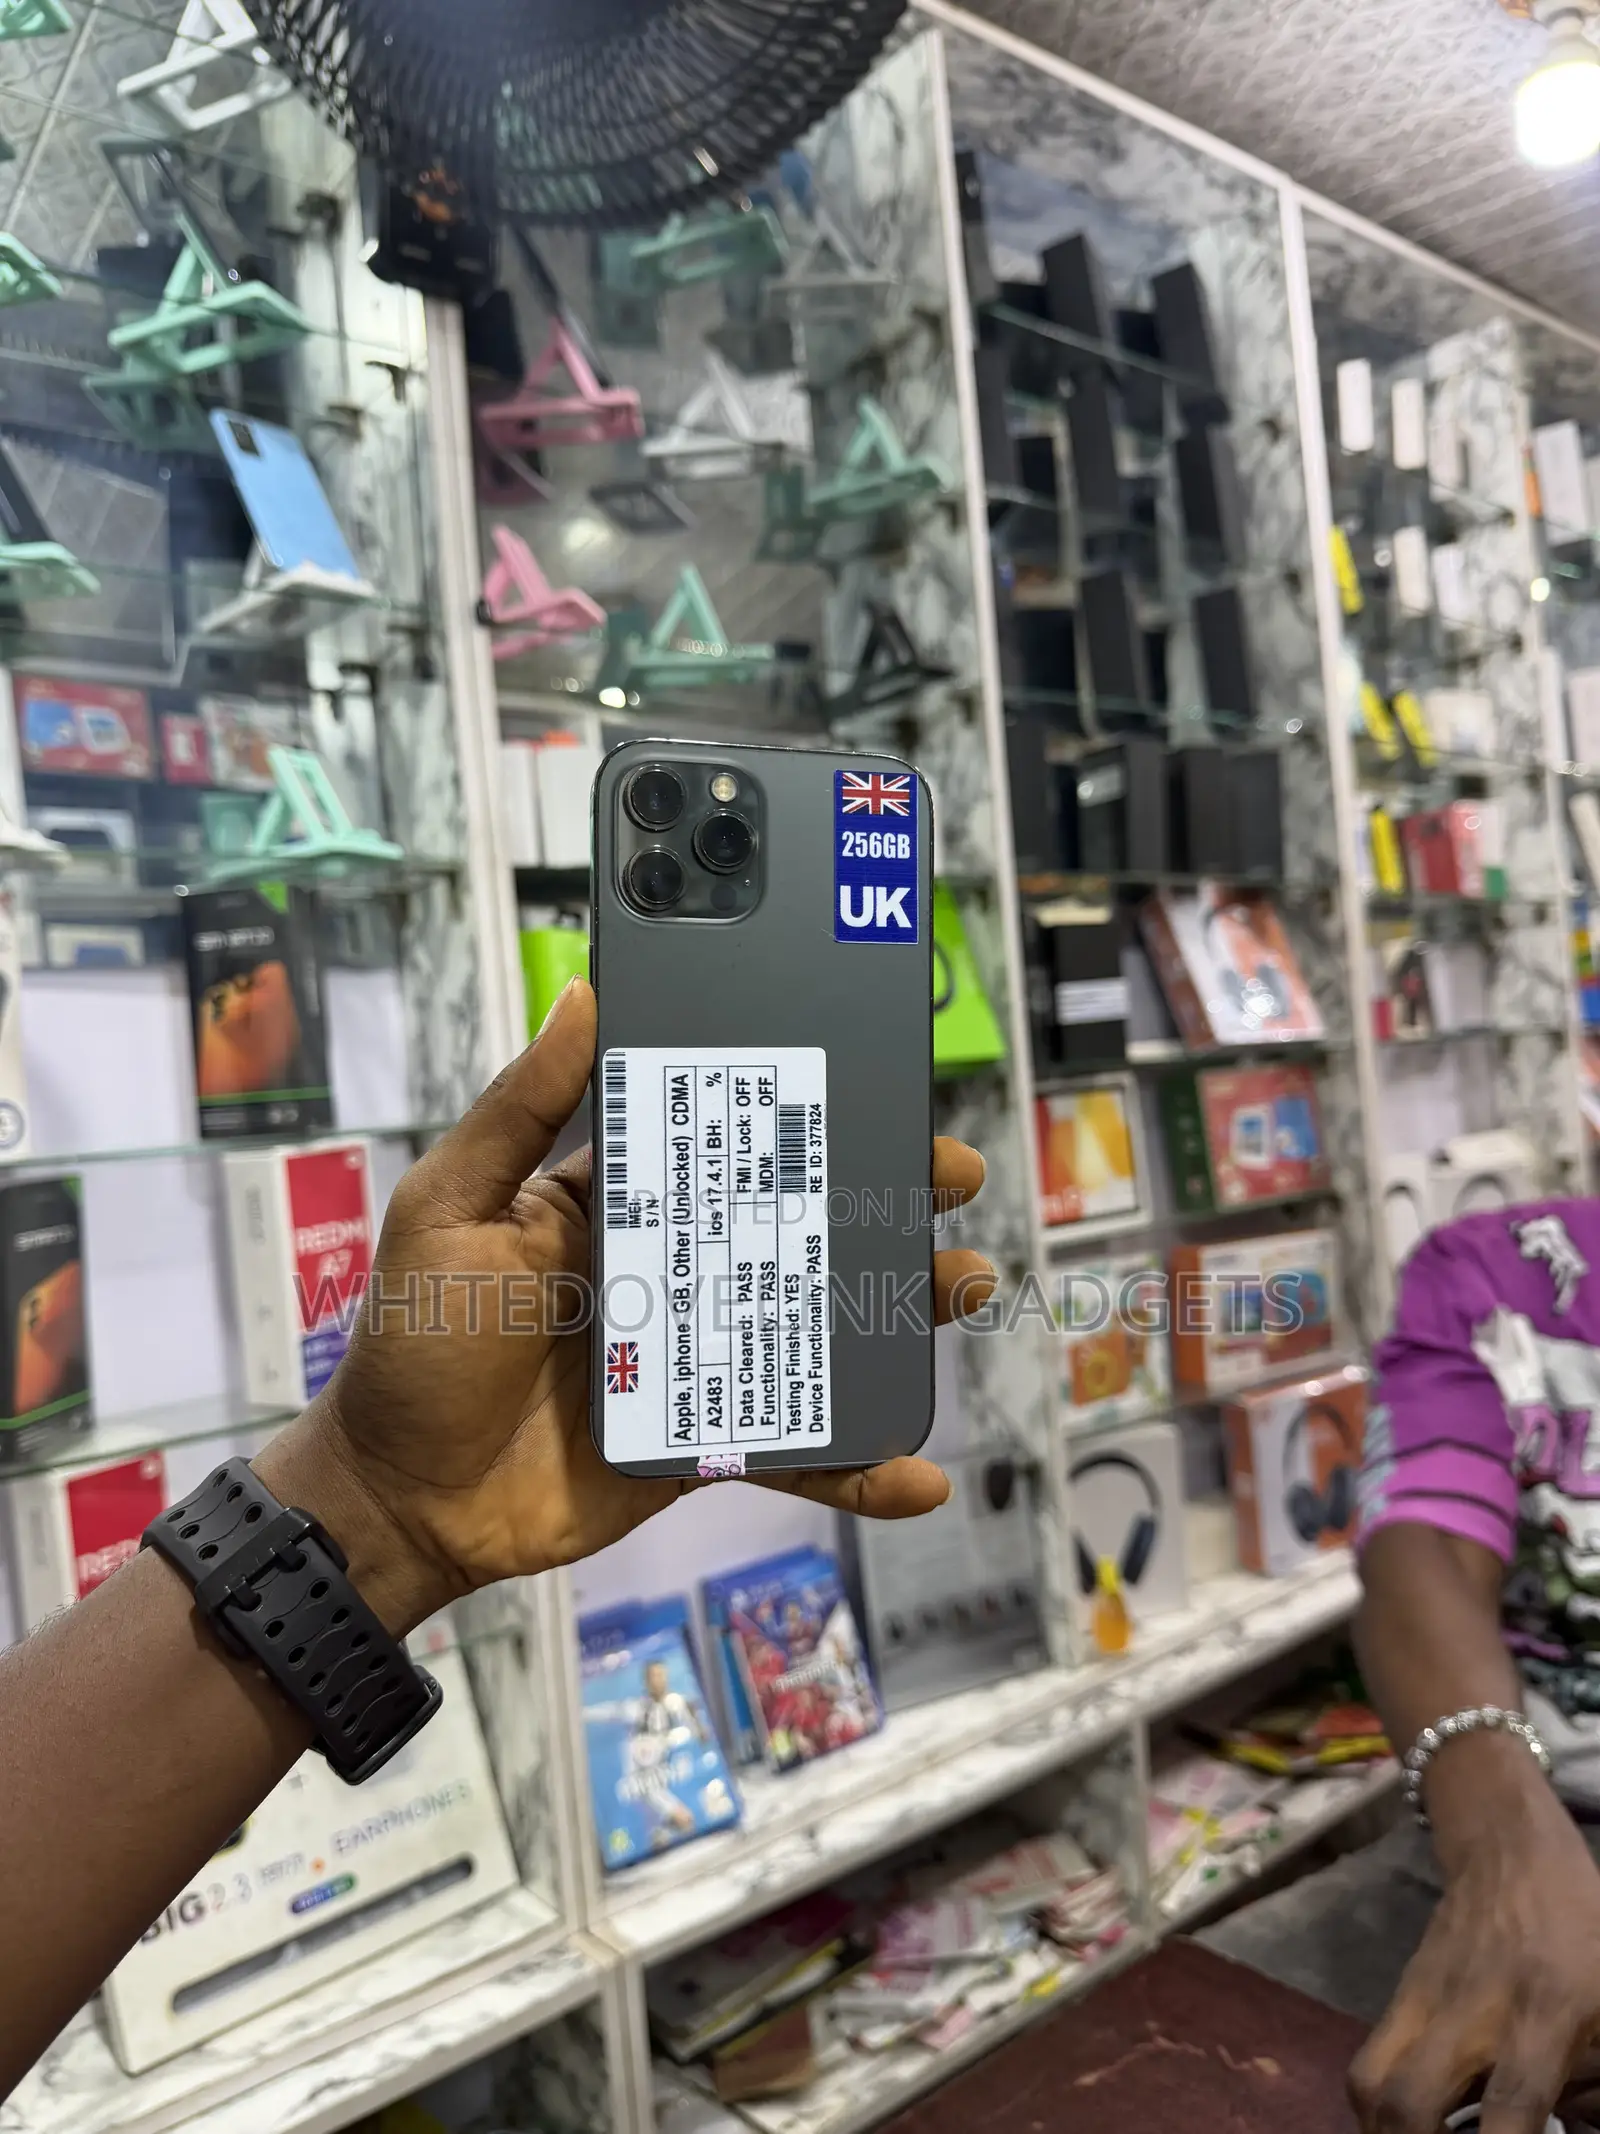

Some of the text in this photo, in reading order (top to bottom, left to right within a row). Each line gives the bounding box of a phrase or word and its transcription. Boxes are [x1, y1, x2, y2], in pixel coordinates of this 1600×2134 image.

[841, 831, 910, 859] 256GB
[839, 885, 912, 929] UK
[706, 1072, 722, 1148] BH: %
[736, 1077, 750, 1106] OFF
[737, 1115, 751, 1153] Lock:
[759, 1077, 774, 1192] MDM: OFF
[809, 1103, 822, 1193] RE ID: 377824
[629, 1198, 641, 1228] IMEI:
[707, 1159, 723, 1236] ios 17.4.1
[737, 1167, 751, 1193] FMI
[671, 1074, 695, 1441] Apple, iphone GB, Other (Unlocked) CDMA
[737, 1262, 754, 1427] Data Cleared: PASS
[760, 1261, 778, 1426] Functionality: PASS
[785, 1274, 803, 1434] Testing Finished: YES
[807, 1235, 826, 1433] Device Functionality: PASS
[708, 1377, 723, 1428] A2483
